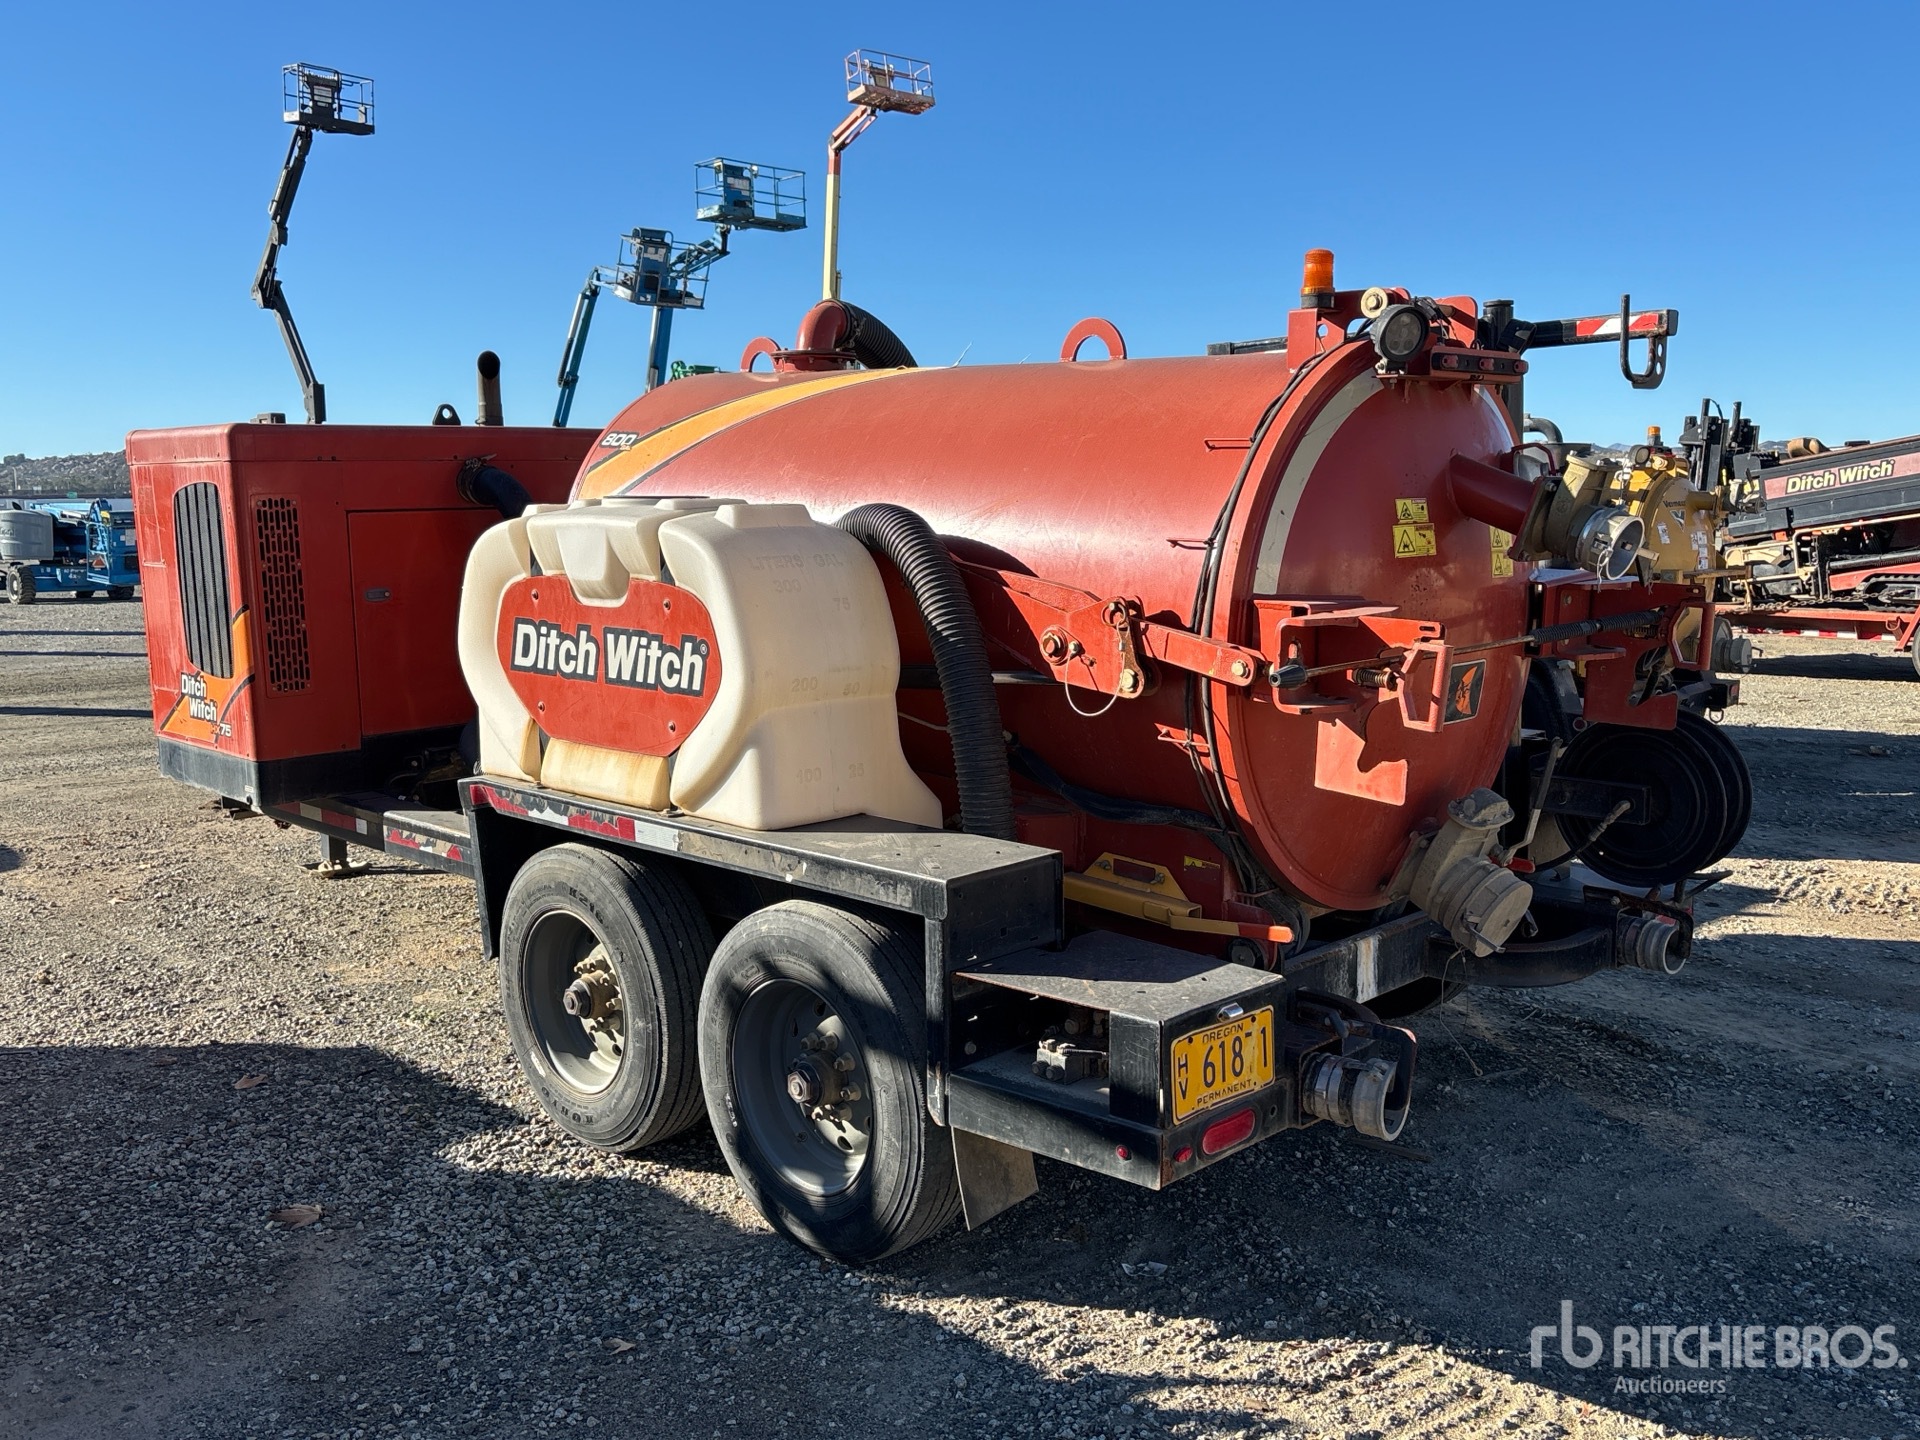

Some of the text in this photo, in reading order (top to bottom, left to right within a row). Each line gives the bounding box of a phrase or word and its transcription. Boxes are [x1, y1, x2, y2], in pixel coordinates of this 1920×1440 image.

[600, 432, 638, 446] 800
[1786, 461, 1894, 493] Ditch Witch
[772, 578, 803, 593] 300
[831, 596, 851, 611] 75
[513, 623, 598, 676] Ditch
[181, 673, 207, 698] Ditch
[790, 676, 818, 693] 200
[189, 697, 217, 722] Witch
[1202, 1022, 1244, 1044] OREGON
[1196, 1079, 1252, 1108] PERMANENT
